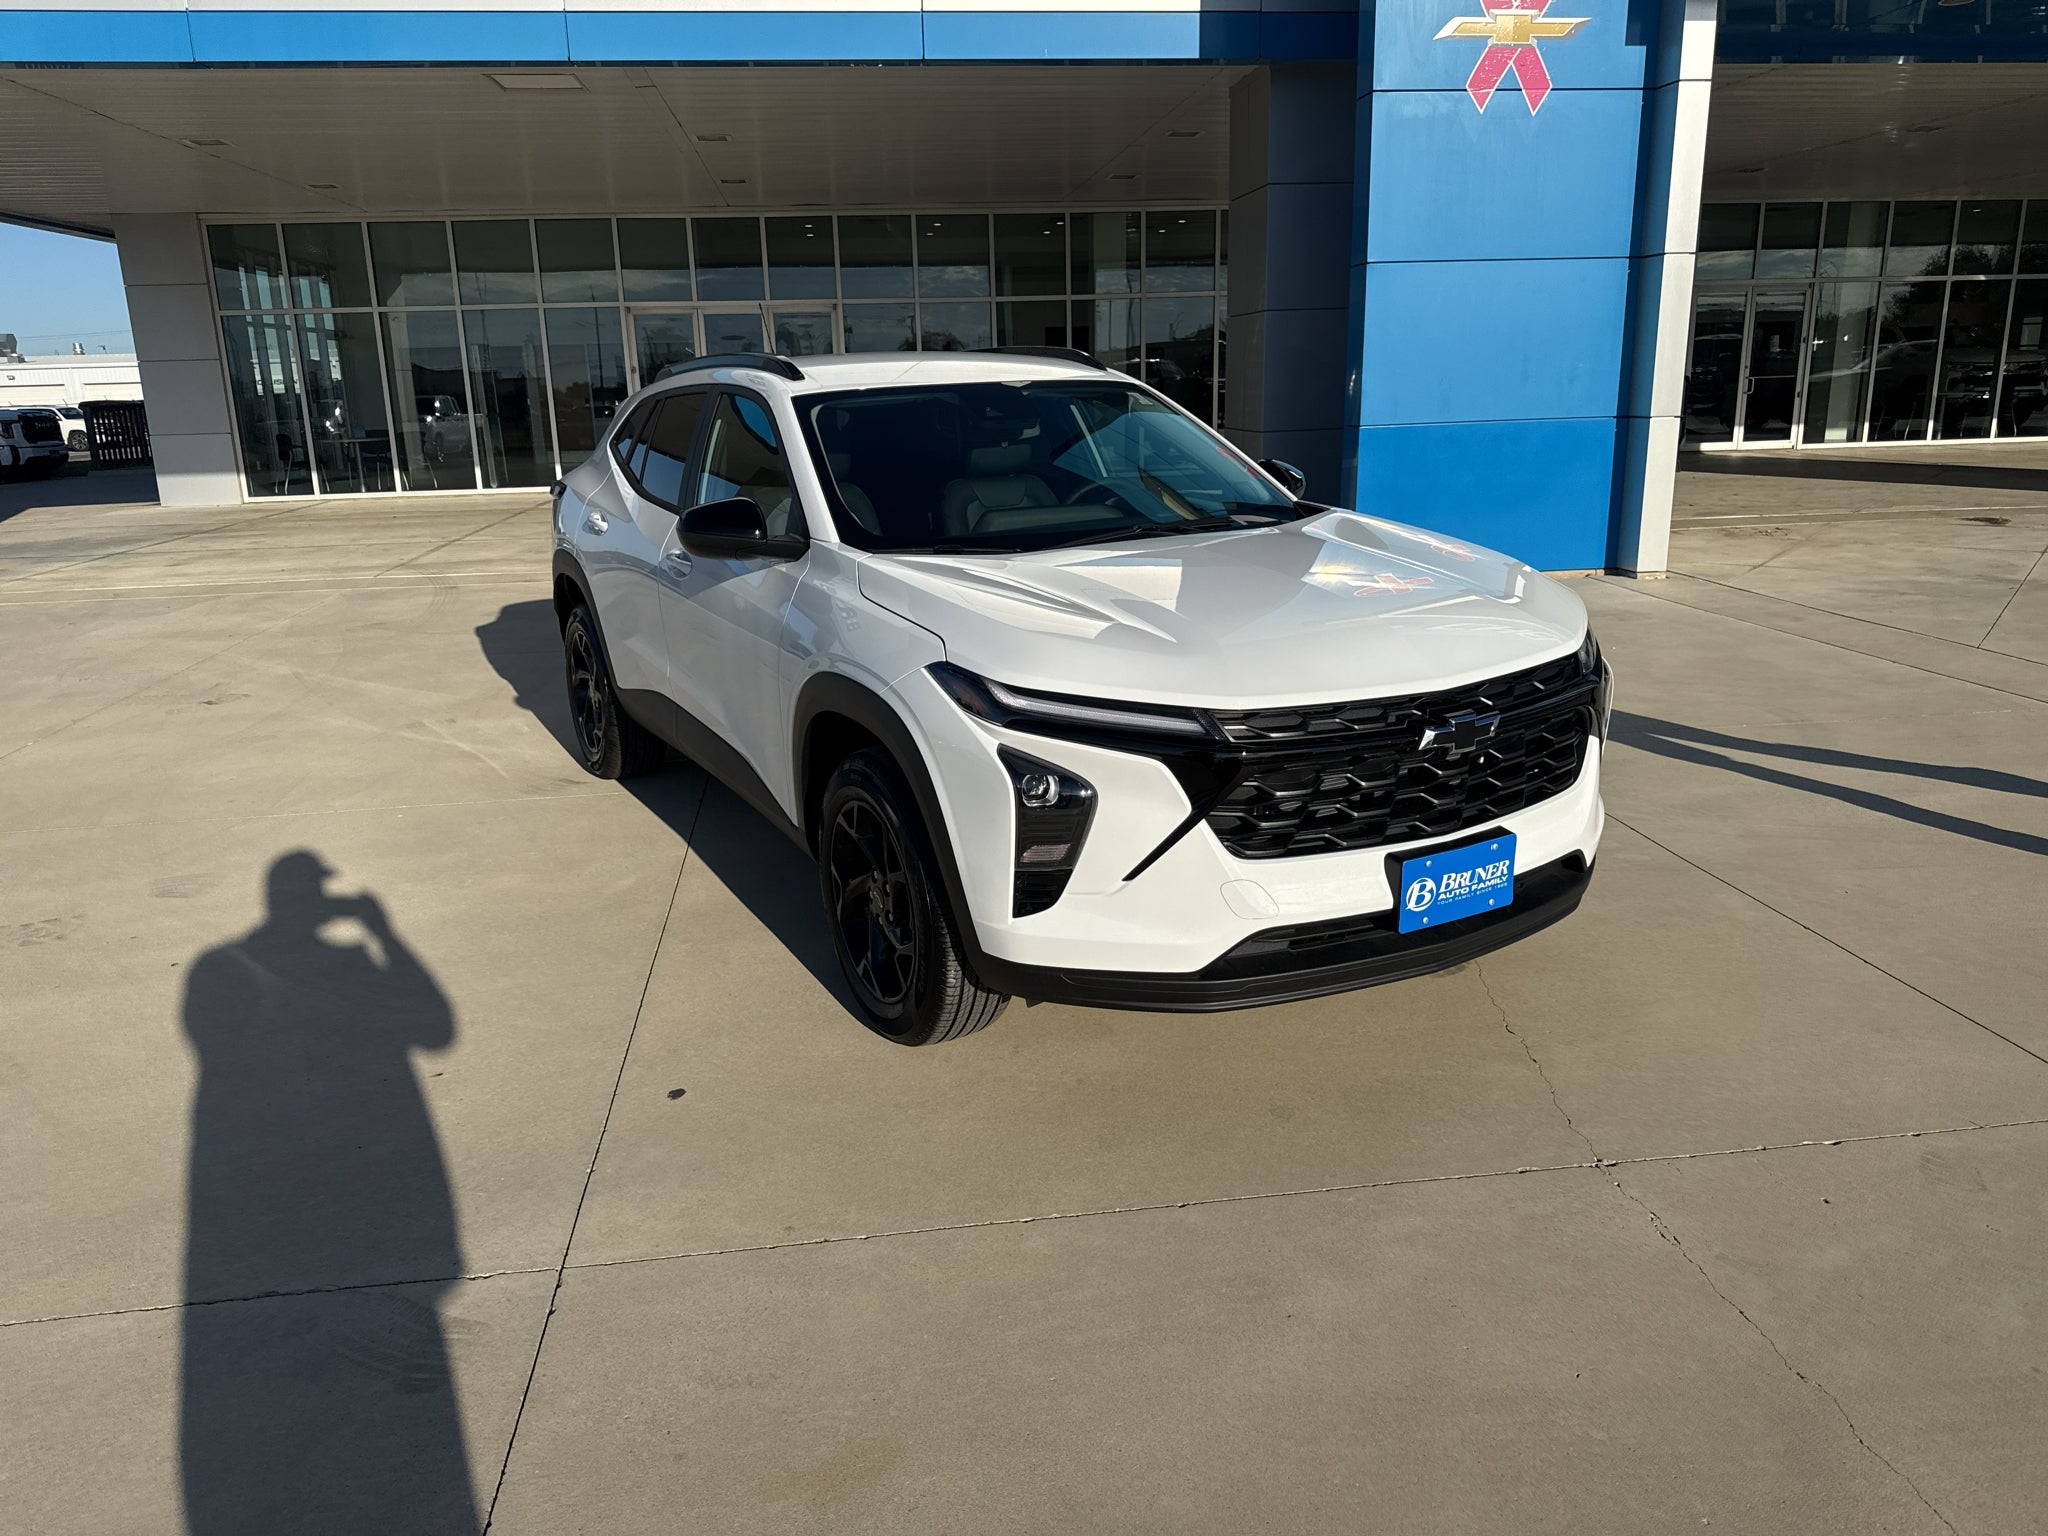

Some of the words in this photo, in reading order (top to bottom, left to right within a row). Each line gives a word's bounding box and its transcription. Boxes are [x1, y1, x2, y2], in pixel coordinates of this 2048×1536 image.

[1437, 888, 1469, 900] AUTO
[1471, 875, 1508, 891] FAMILY
[1438, 860, 1510, 894] BRUNER
[1405, 879, 1435, 911] B
[1455, 893, 1474, 901] FAMILY
[1476, 887, 1492, 895] SINCE
